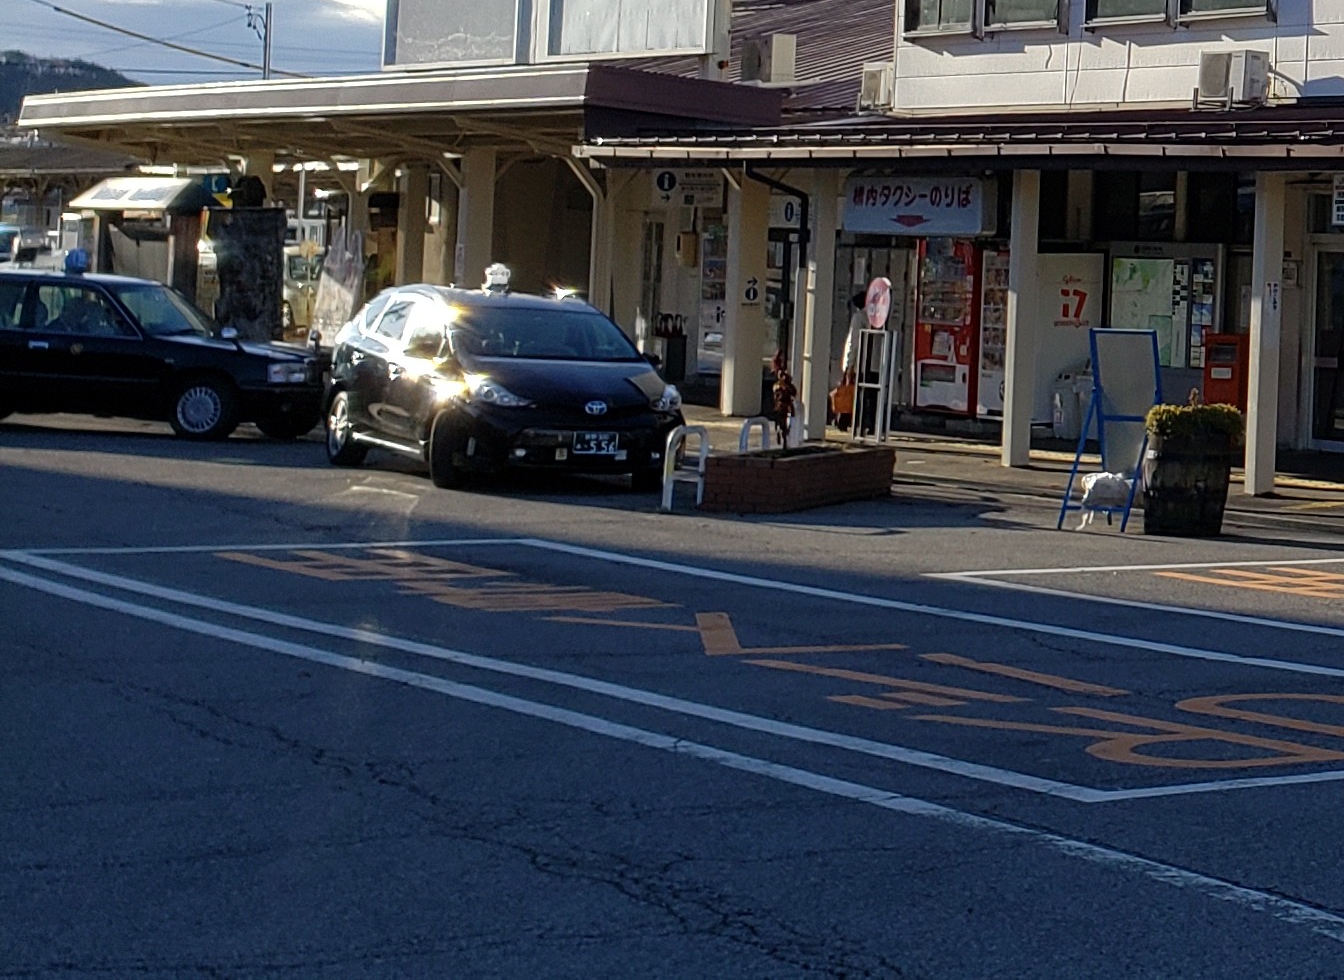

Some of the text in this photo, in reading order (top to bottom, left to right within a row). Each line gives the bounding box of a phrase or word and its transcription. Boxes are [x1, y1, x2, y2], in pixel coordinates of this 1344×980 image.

[852, 183, 974, 209] 構内タクシーのりば
